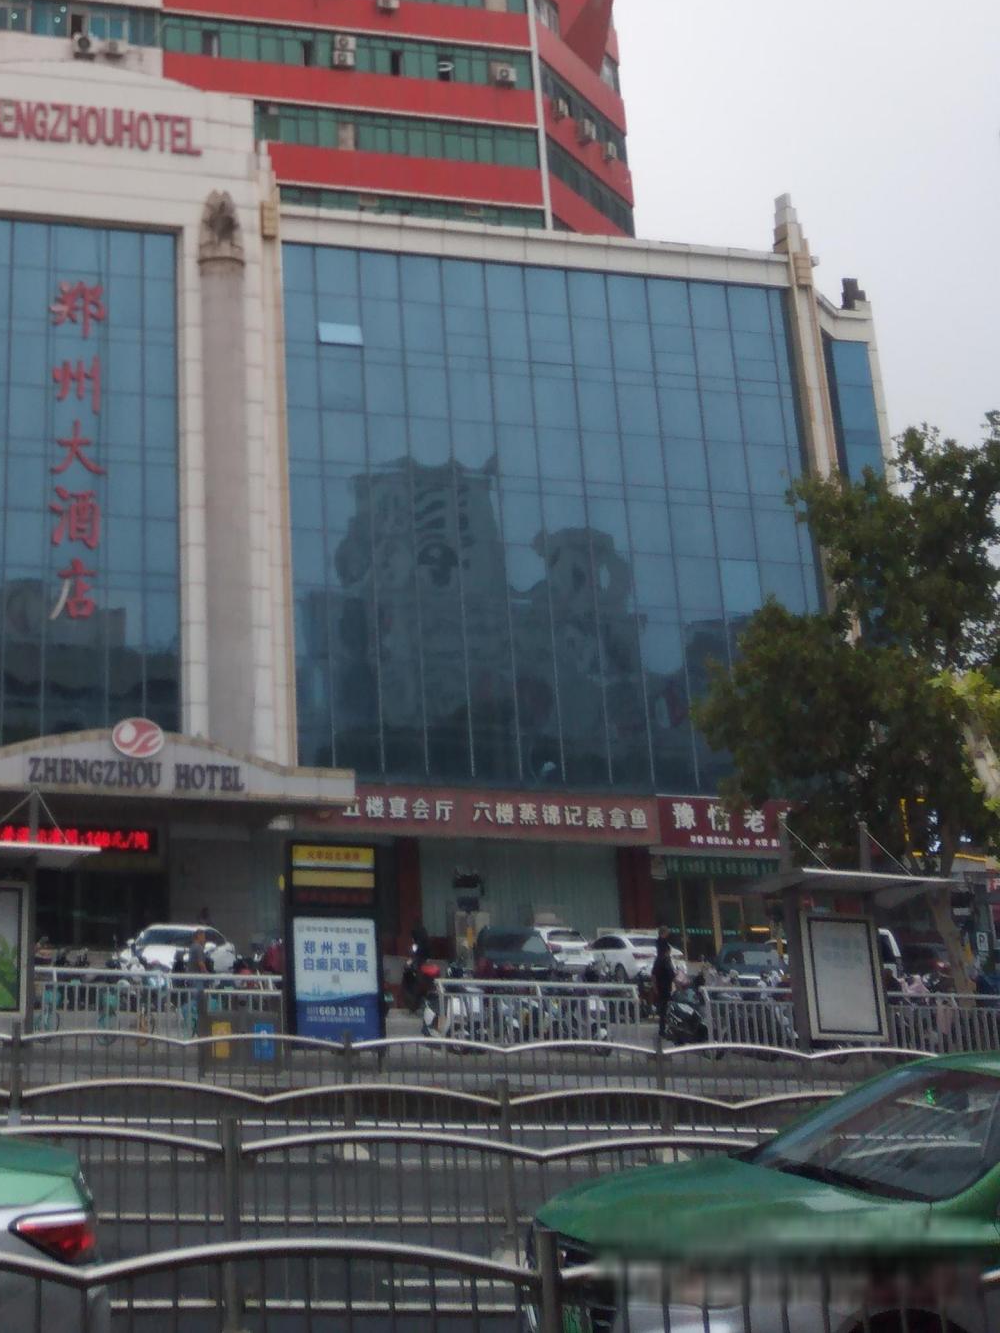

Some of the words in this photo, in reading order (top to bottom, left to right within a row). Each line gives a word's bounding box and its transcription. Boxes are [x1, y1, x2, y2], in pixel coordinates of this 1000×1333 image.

[48, 280, 107, 621] 郑州大酒店
[28, 757, 162, 788] ZHENGZHOU
[174, 763, 246, 792] HOTEL
